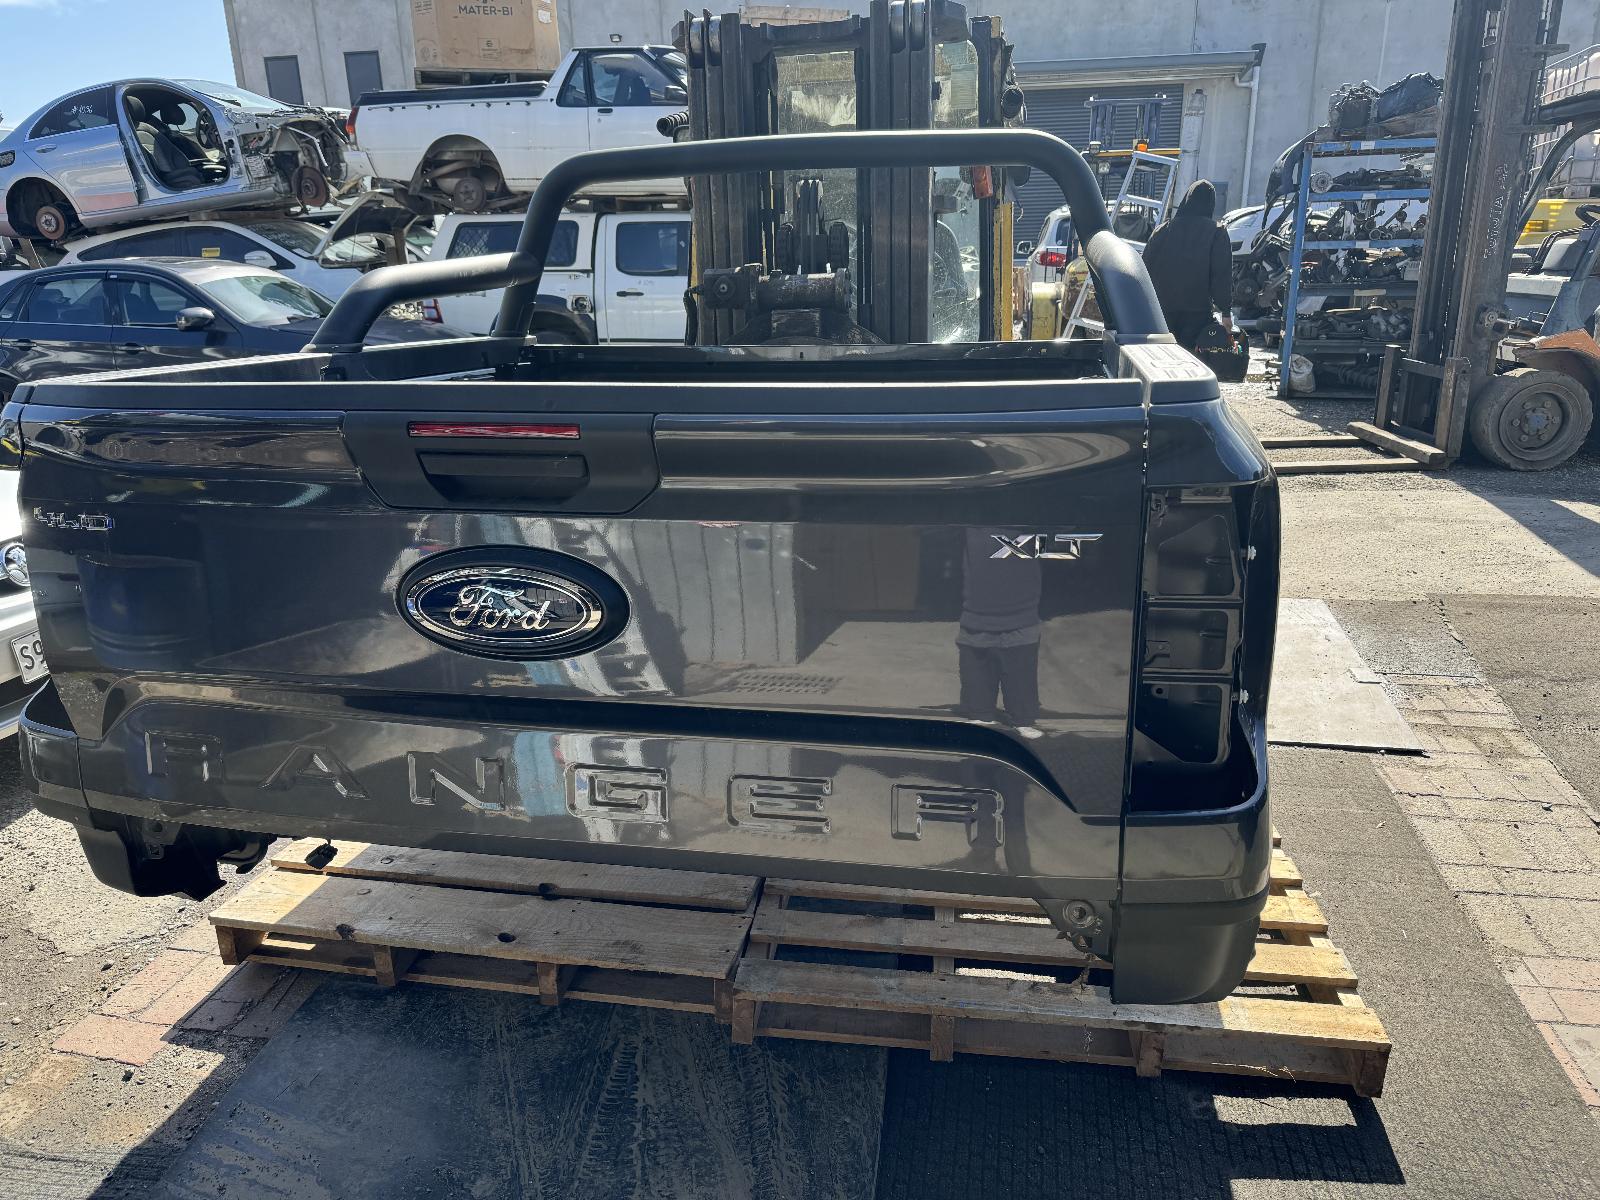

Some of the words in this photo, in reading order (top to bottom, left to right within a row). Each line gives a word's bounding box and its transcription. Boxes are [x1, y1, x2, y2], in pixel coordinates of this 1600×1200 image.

[458, 5, 513, 16] MATER-BI
[989, 533, 1104, 560] XLT
[449, 584, 551, 630] Ford
[144, 730, 1004, 847] RANGER
